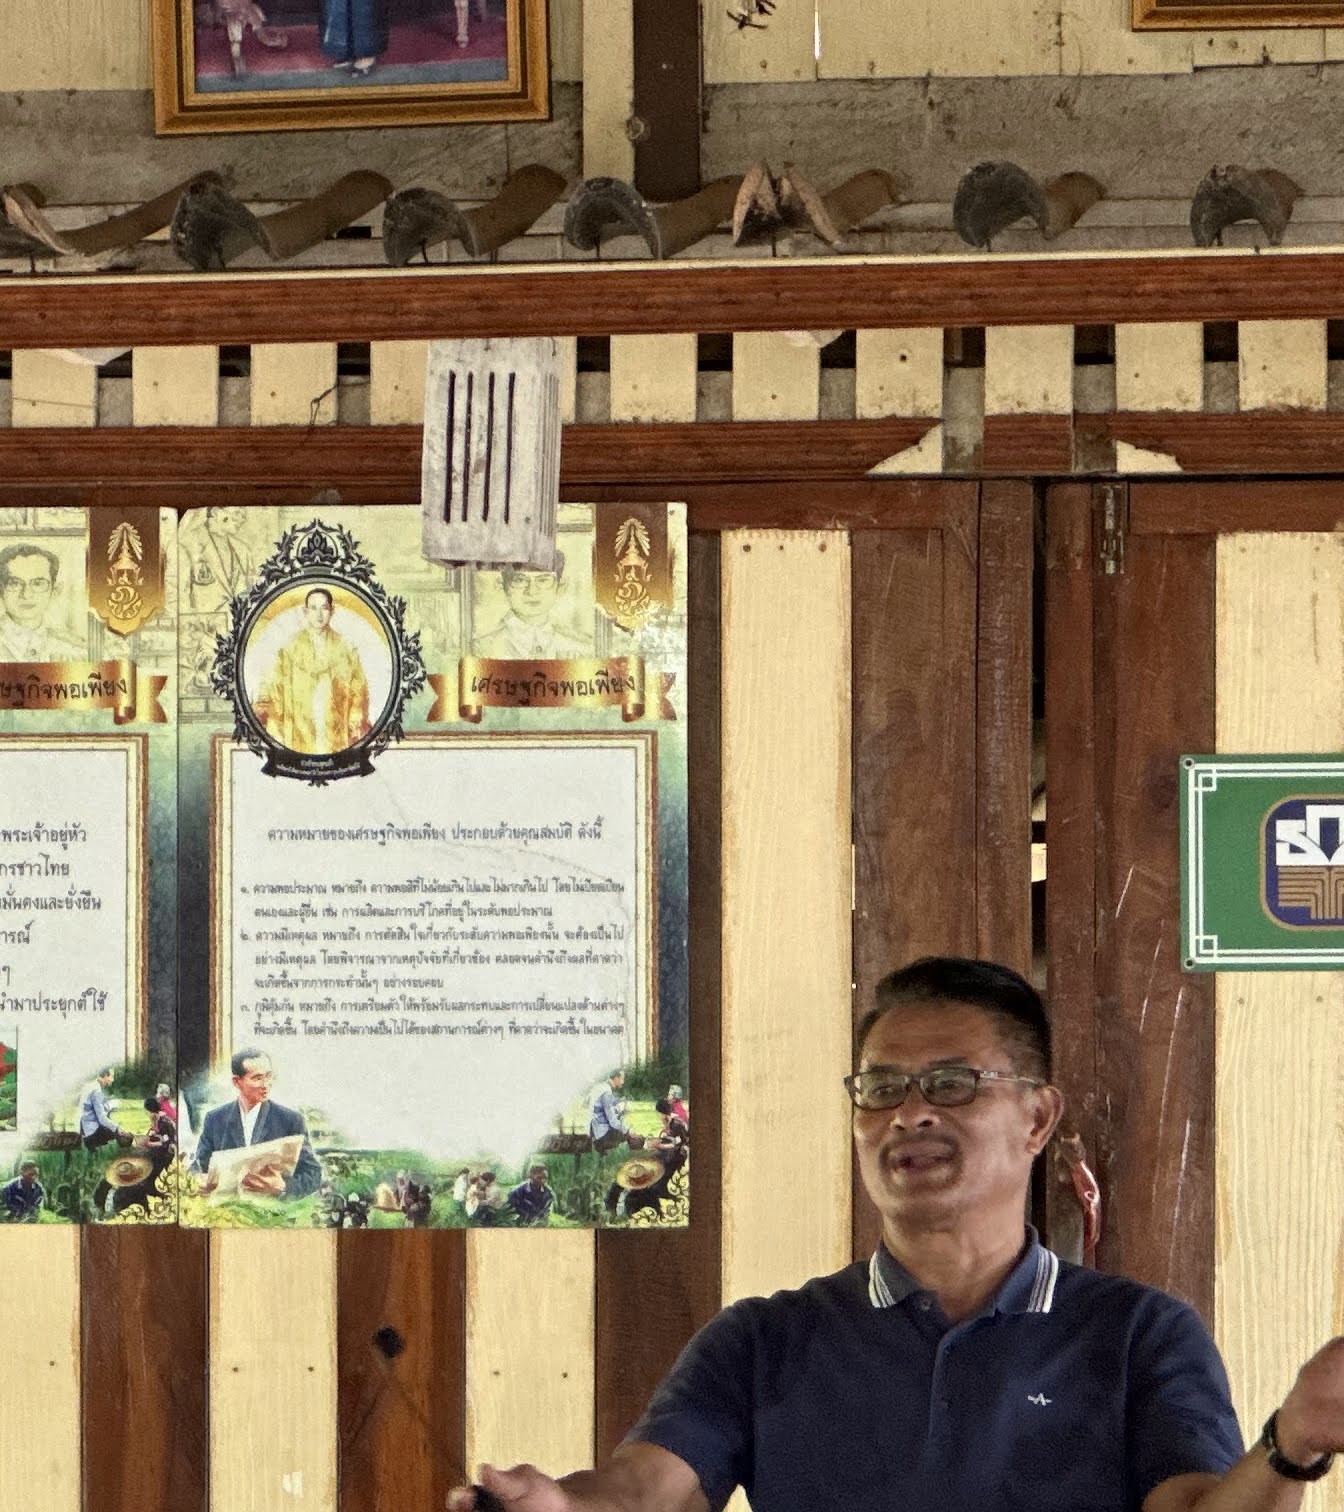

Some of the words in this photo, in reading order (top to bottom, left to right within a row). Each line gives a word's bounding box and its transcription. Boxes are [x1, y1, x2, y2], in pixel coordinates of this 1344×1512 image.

[471, 669, 636, 707] เศรษฐกิจพอเพียง
